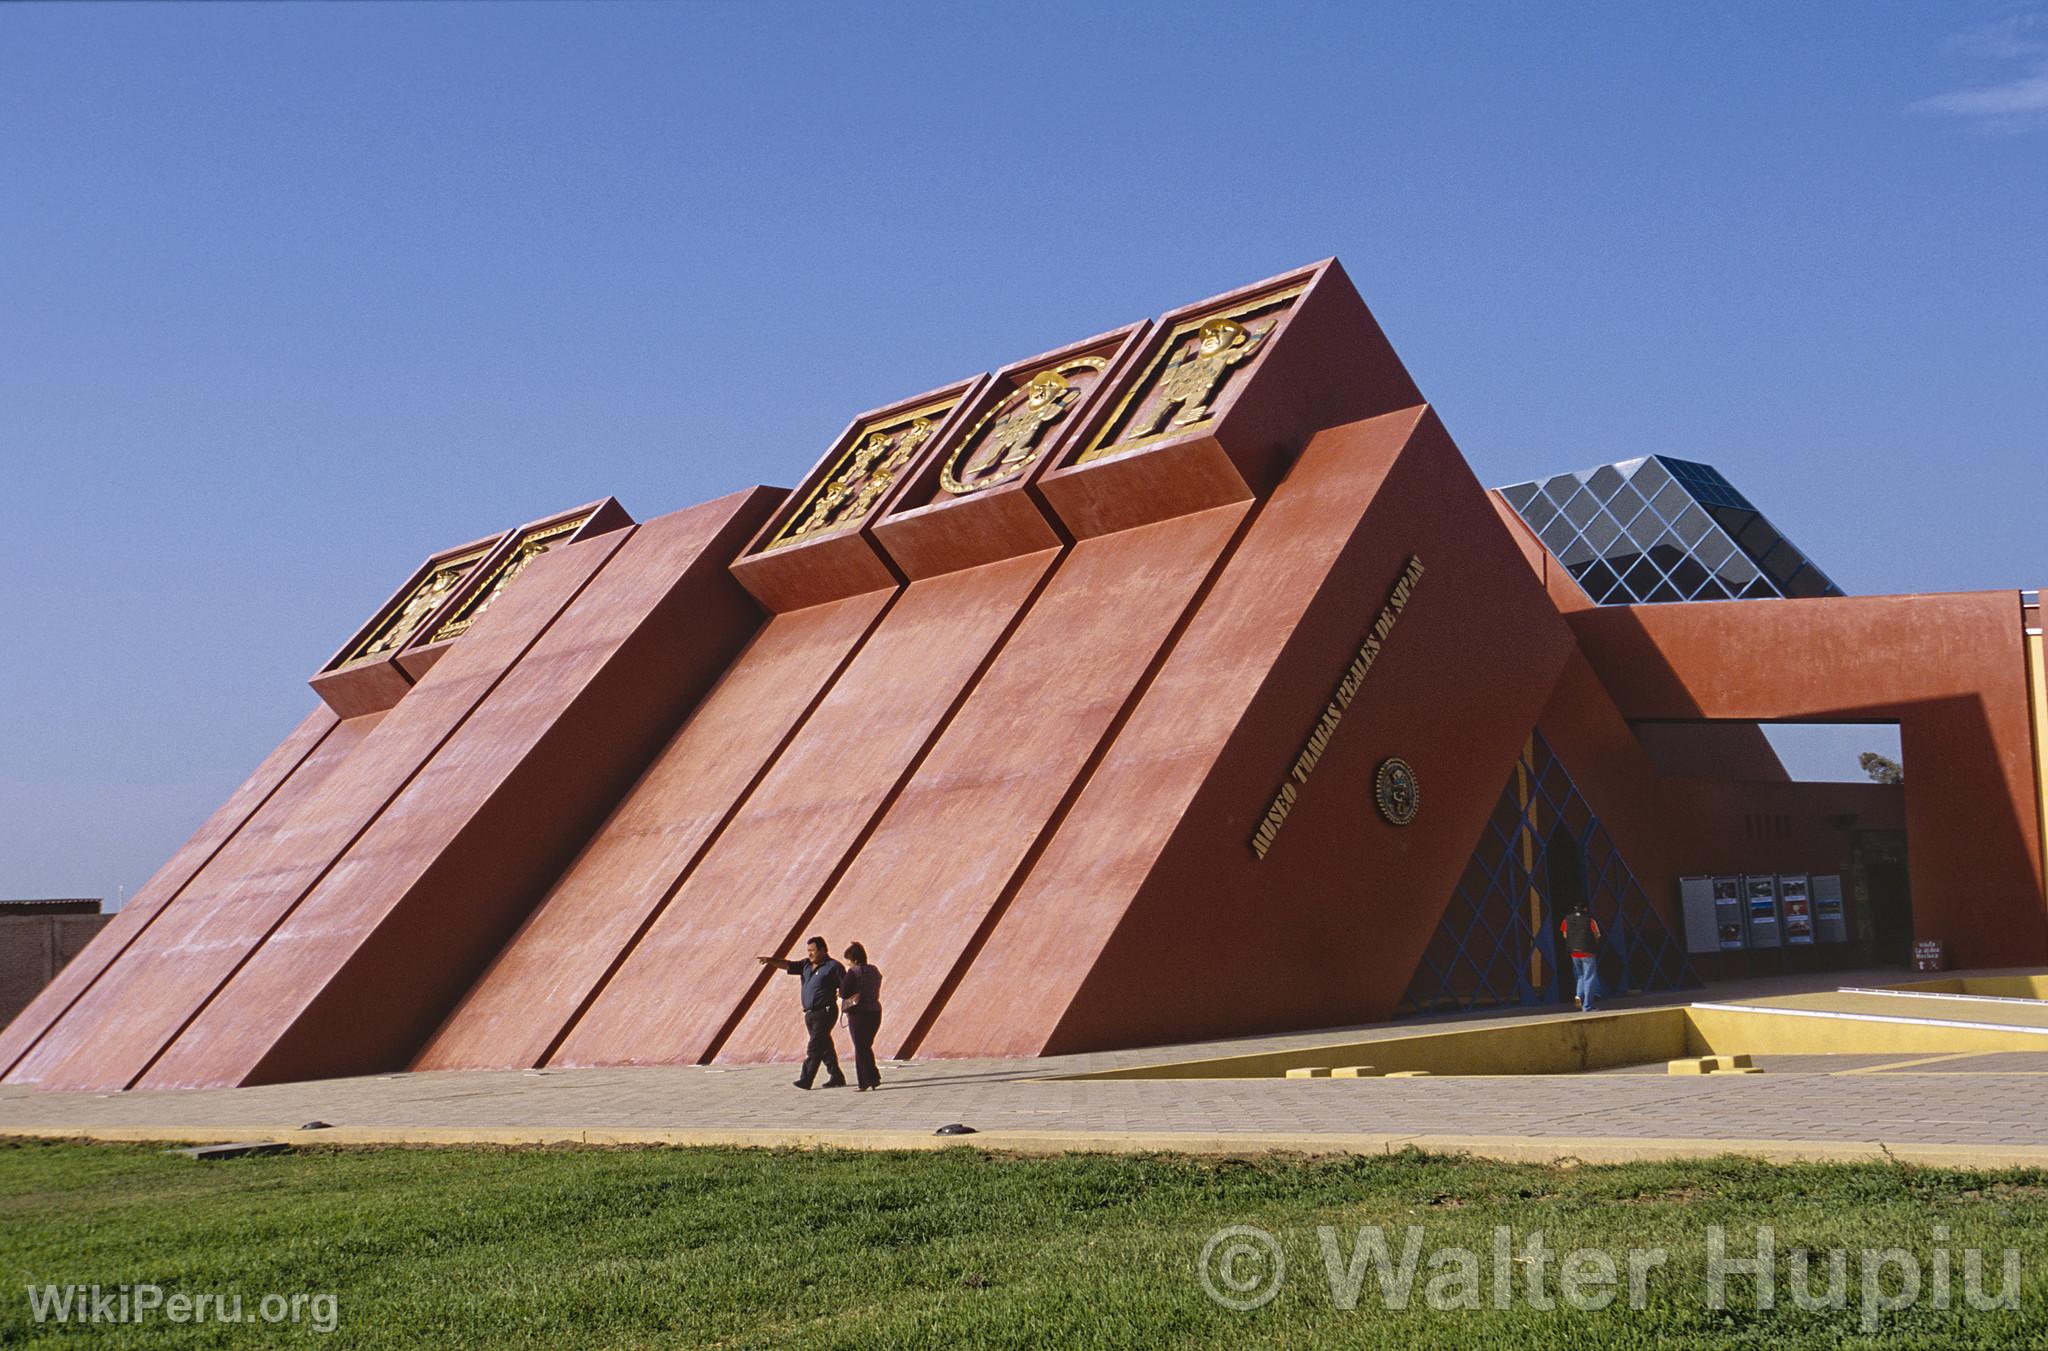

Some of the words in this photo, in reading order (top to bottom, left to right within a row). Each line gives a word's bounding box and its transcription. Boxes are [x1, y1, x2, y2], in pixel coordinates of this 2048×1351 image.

[1252, 782, 1297, 861] MUSEO
[1291, 702, 1343, 784] TUMBAS
[1335, 632, 1381, 711] REALES
[1374, 606, 1397, 641] DE
